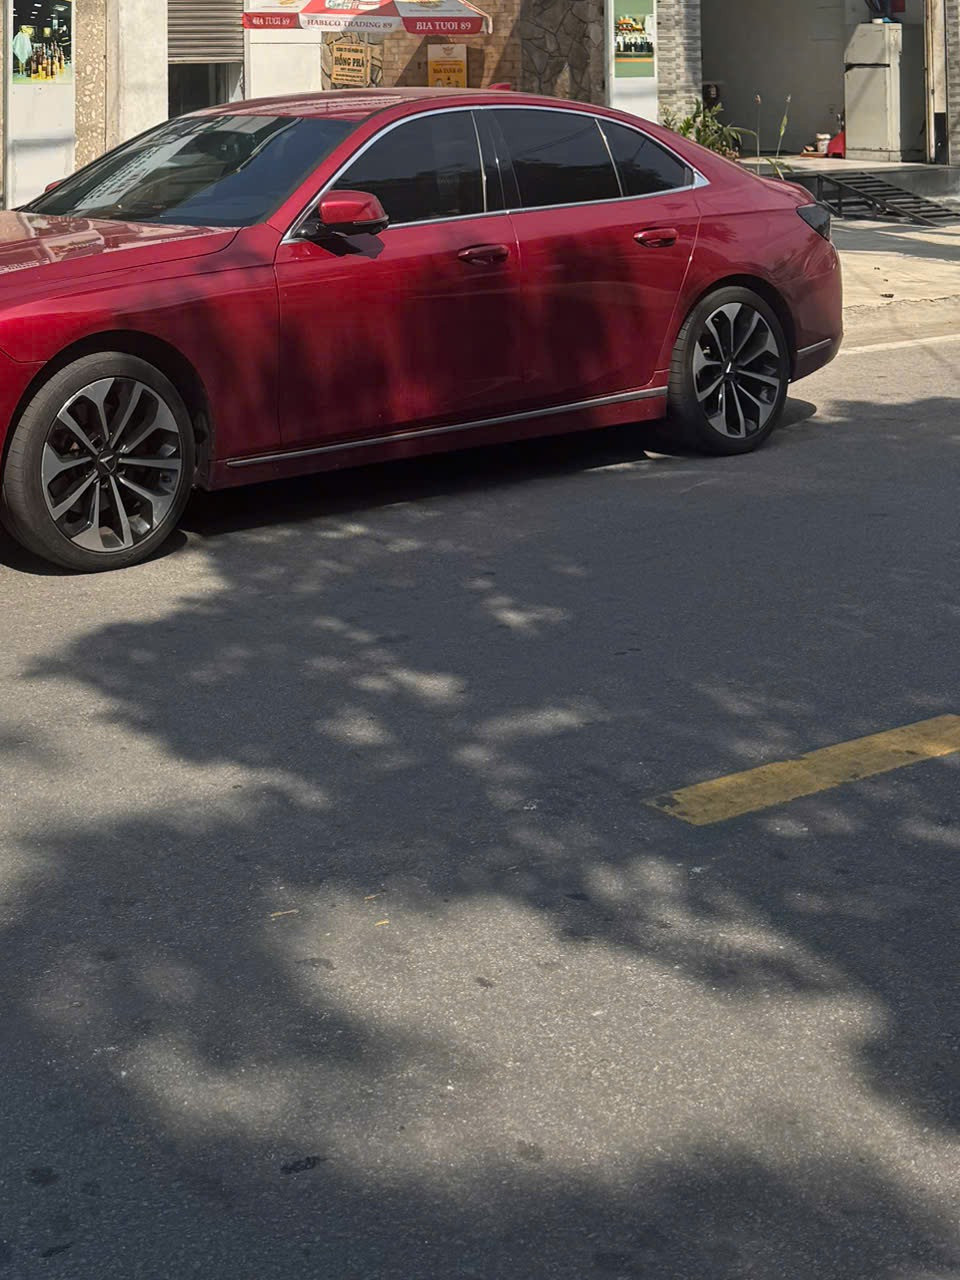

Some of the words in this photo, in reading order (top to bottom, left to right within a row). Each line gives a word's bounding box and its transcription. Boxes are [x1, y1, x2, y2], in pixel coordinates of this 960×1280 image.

[343, 20, 381, 29] TRADING
[416, 20, 433, 30] BIA
[460, 21, 472, 30] 89
